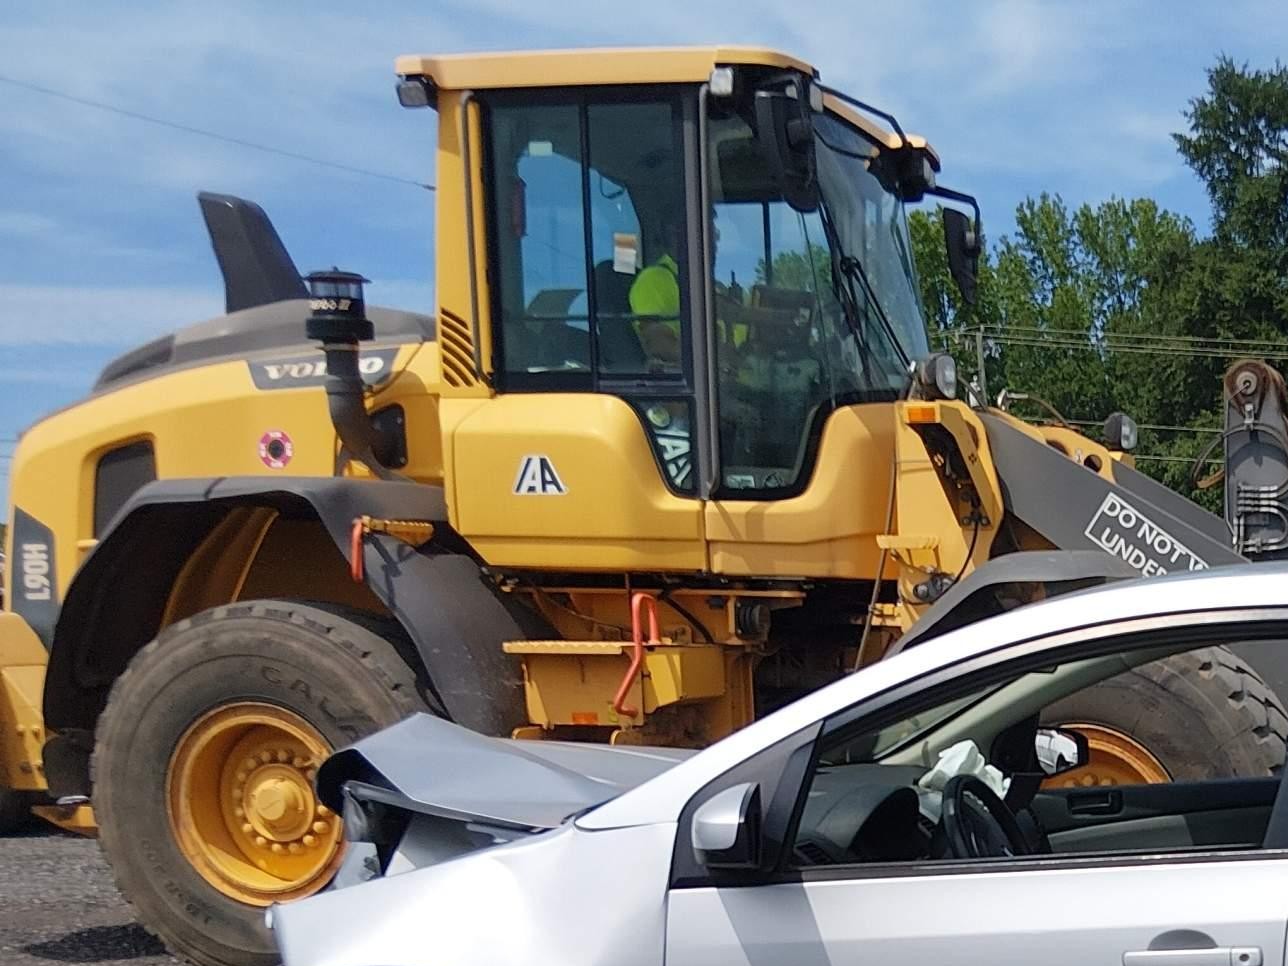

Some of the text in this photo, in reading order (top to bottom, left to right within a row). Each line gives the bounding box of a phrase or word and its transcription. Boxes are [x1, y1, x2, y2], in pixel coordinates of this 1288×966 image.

[263, 356, 384, 380] VOLO
[1103, 500, 1137, 529] DO
[1136, 523, 1186, 564] NOT
[22, 543, 51, 600] L90H
